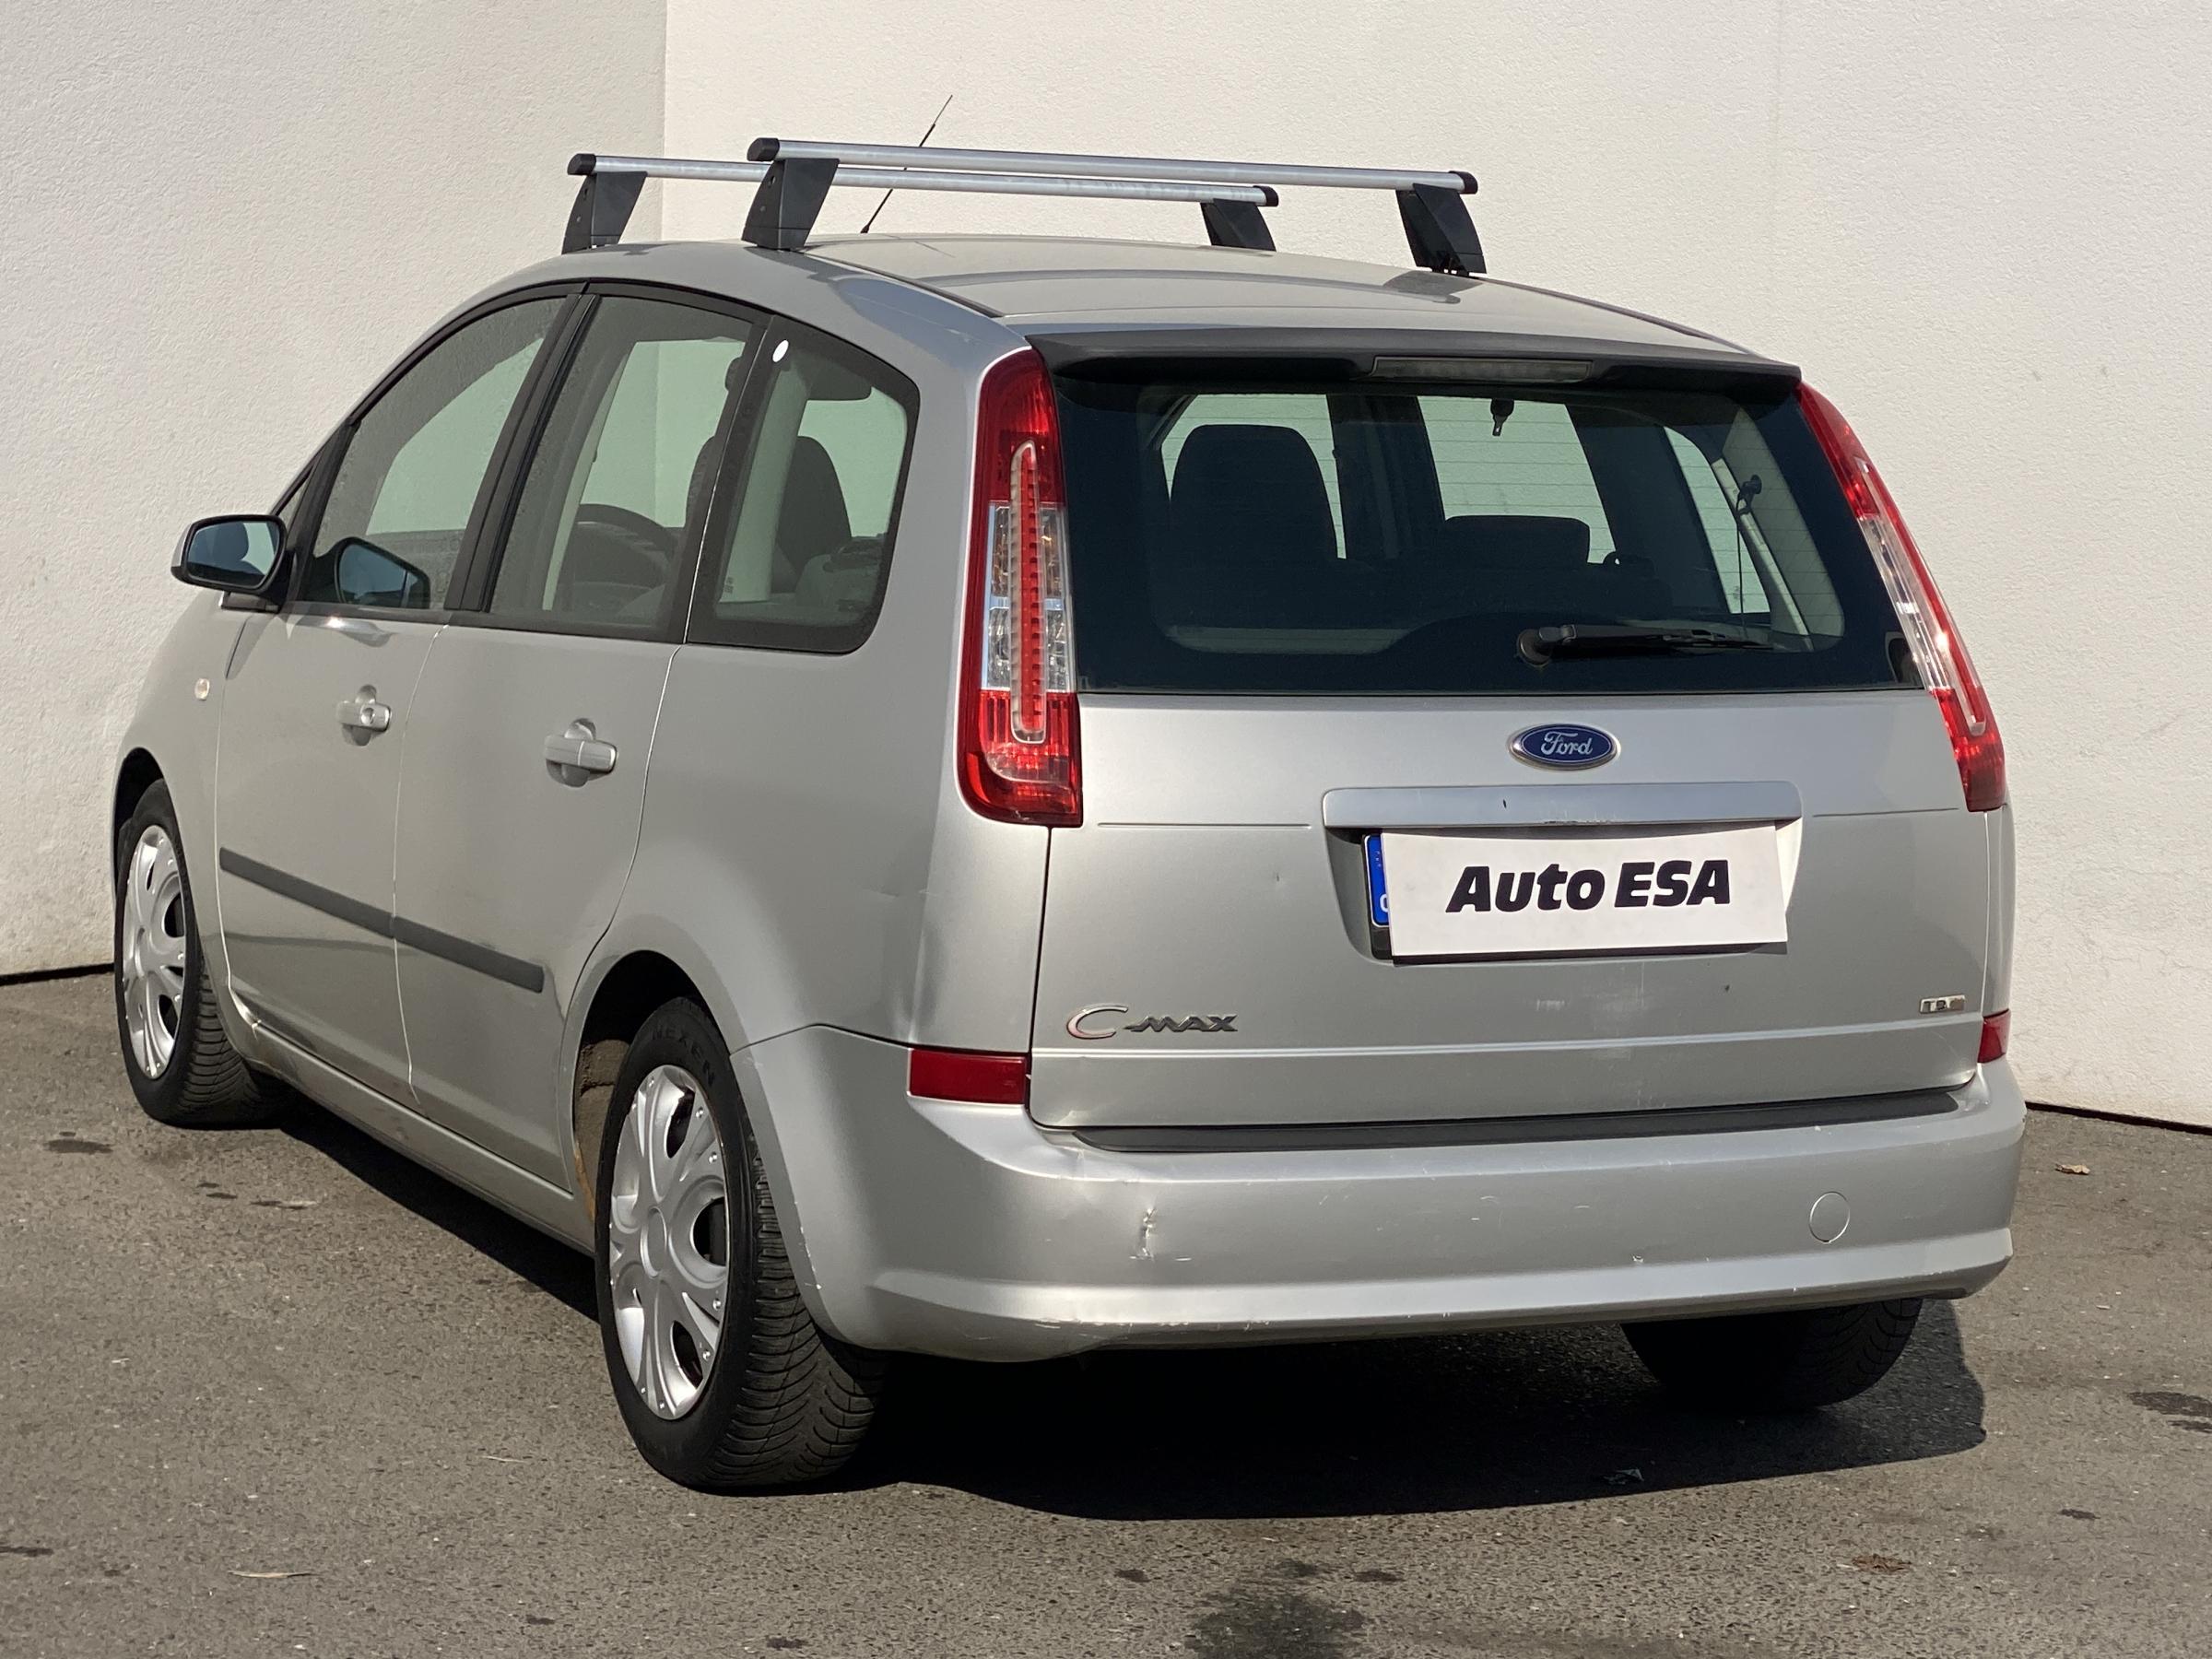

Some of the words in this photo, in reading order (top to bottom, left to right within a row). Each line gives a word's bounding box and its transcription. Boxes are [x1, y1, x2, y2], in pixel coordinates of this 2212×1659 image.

[1540, 731, 1594, 755] Ford
[1445, 864, 1606, 912] Auto
[1614, 859, 1731, 908] ESA
